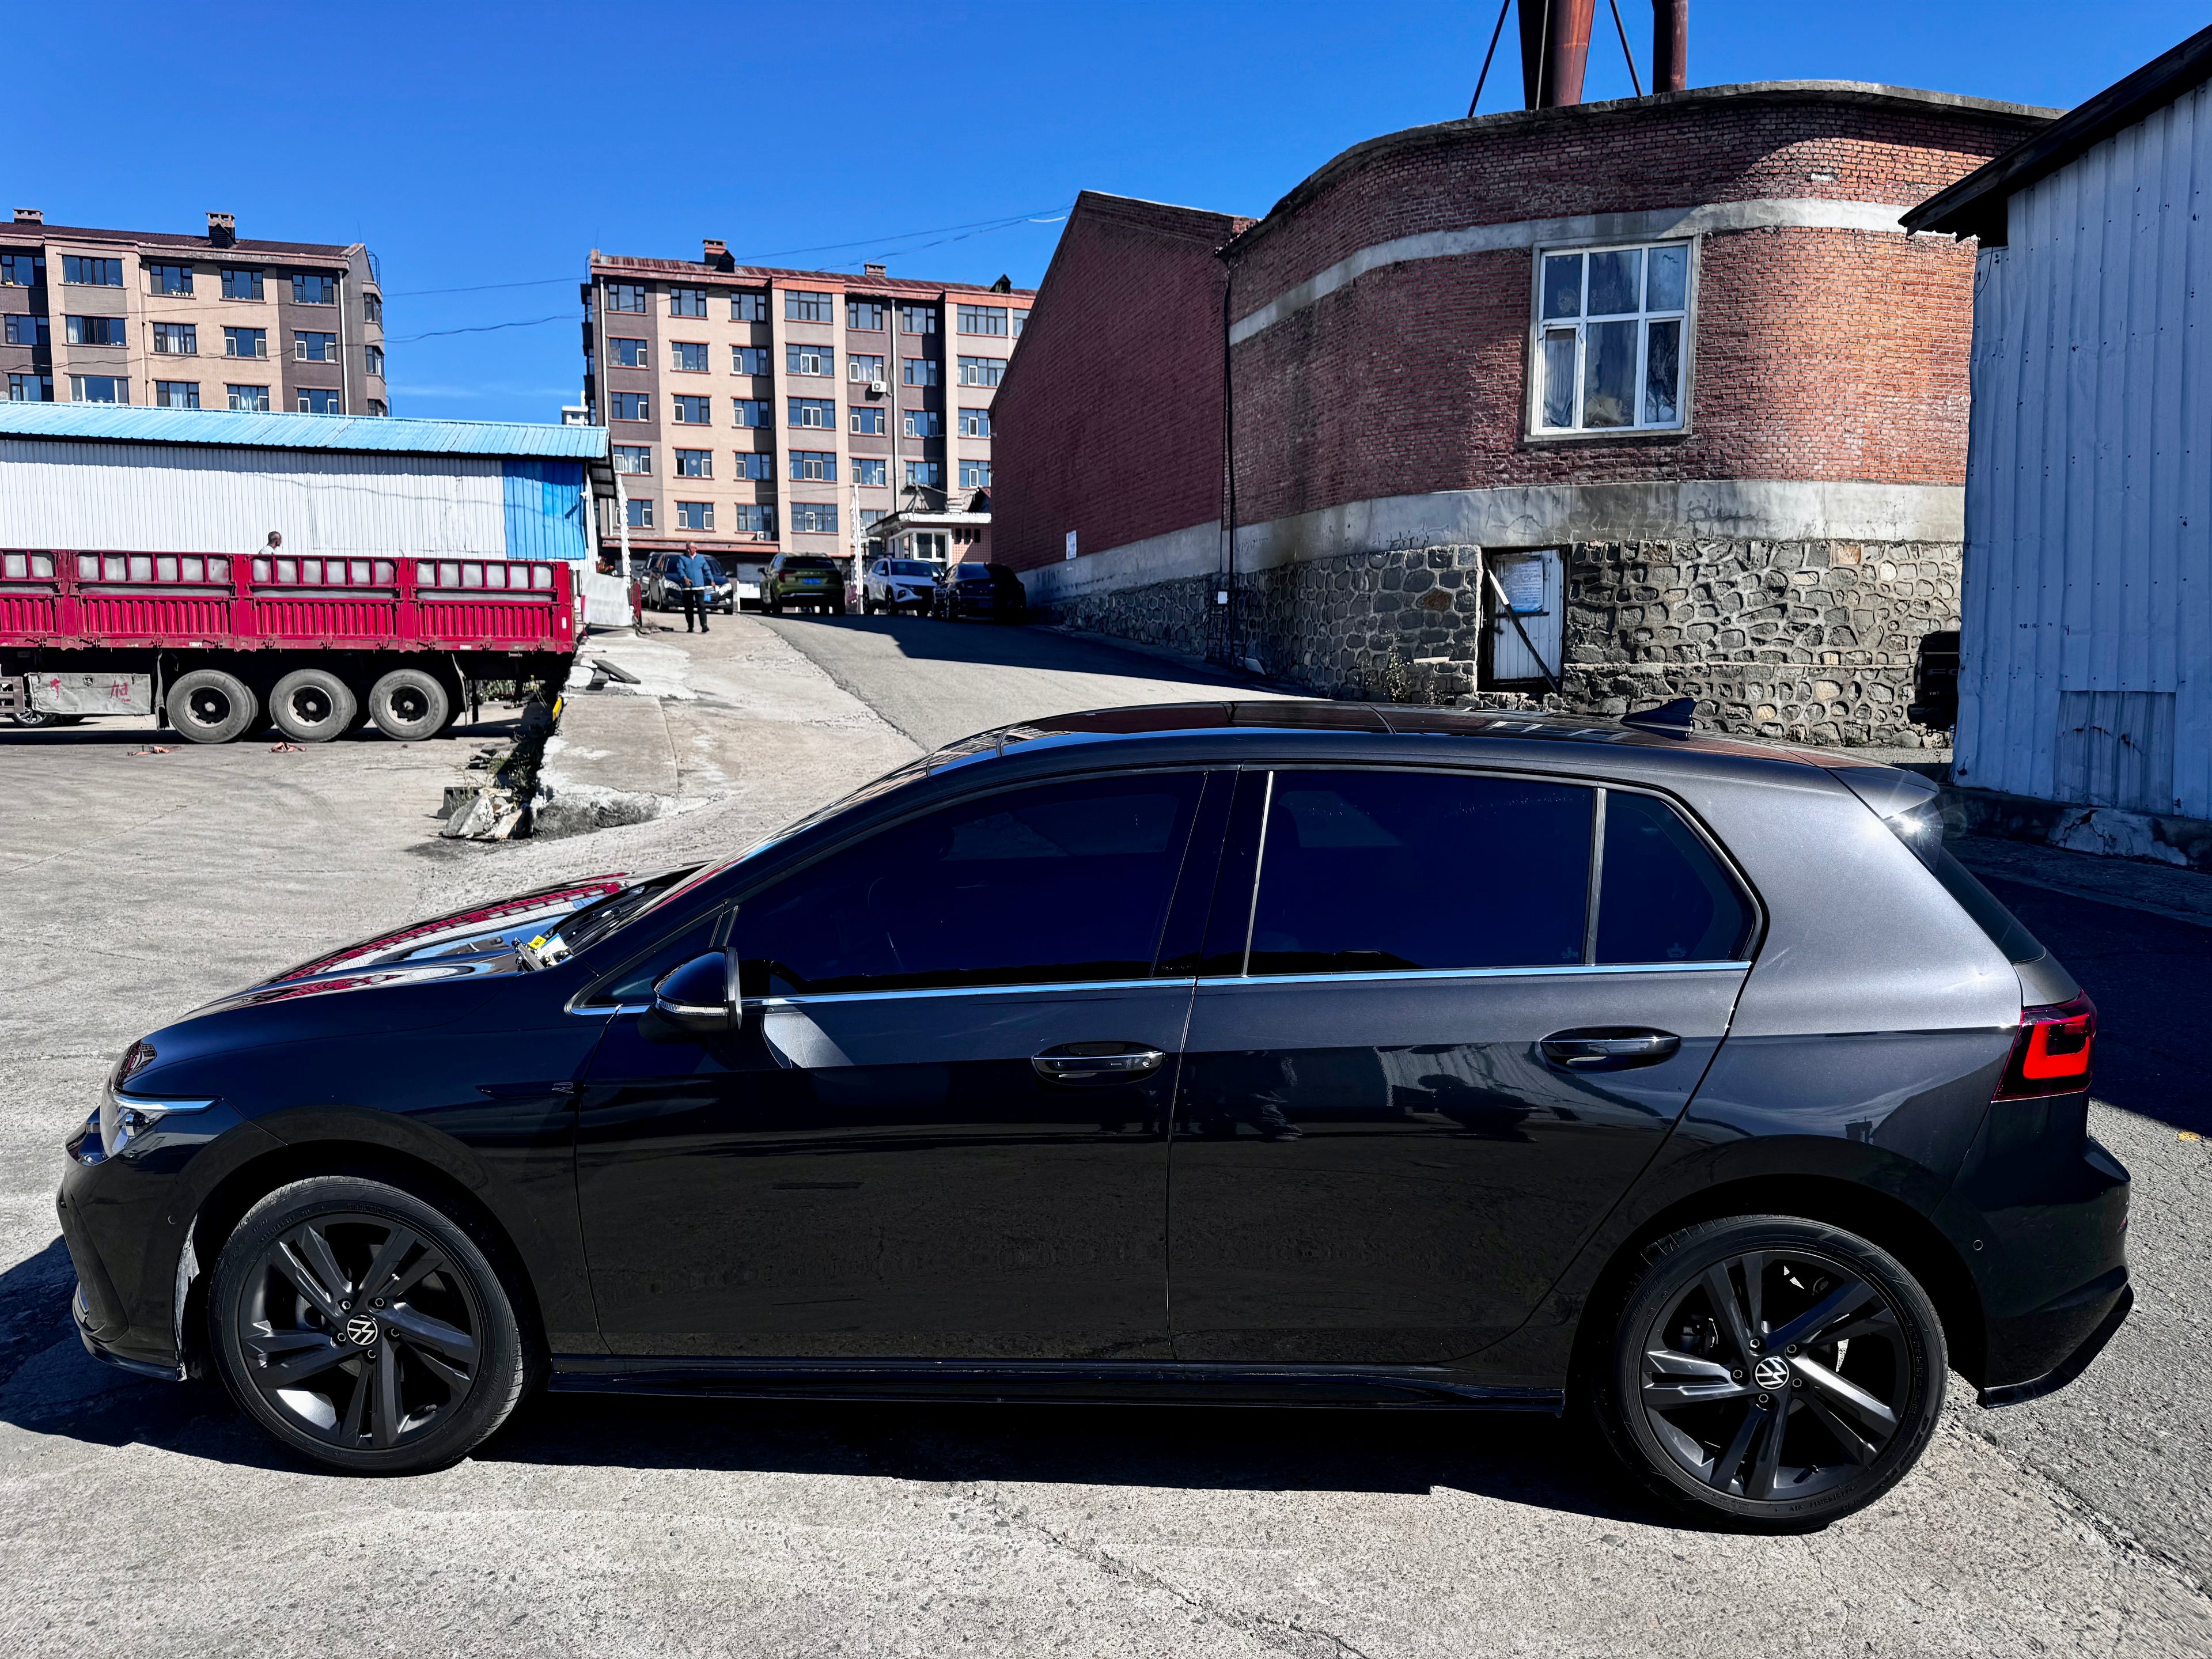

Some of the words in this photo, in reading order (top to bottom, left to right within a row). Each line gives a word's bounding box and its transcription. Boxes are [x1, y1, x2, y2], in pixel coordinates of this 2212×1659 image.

[551, 1082, 574, 1093] R
[347, 1315, 378, 1346] VW
[1755, 1356, 1790, 1390] VW
